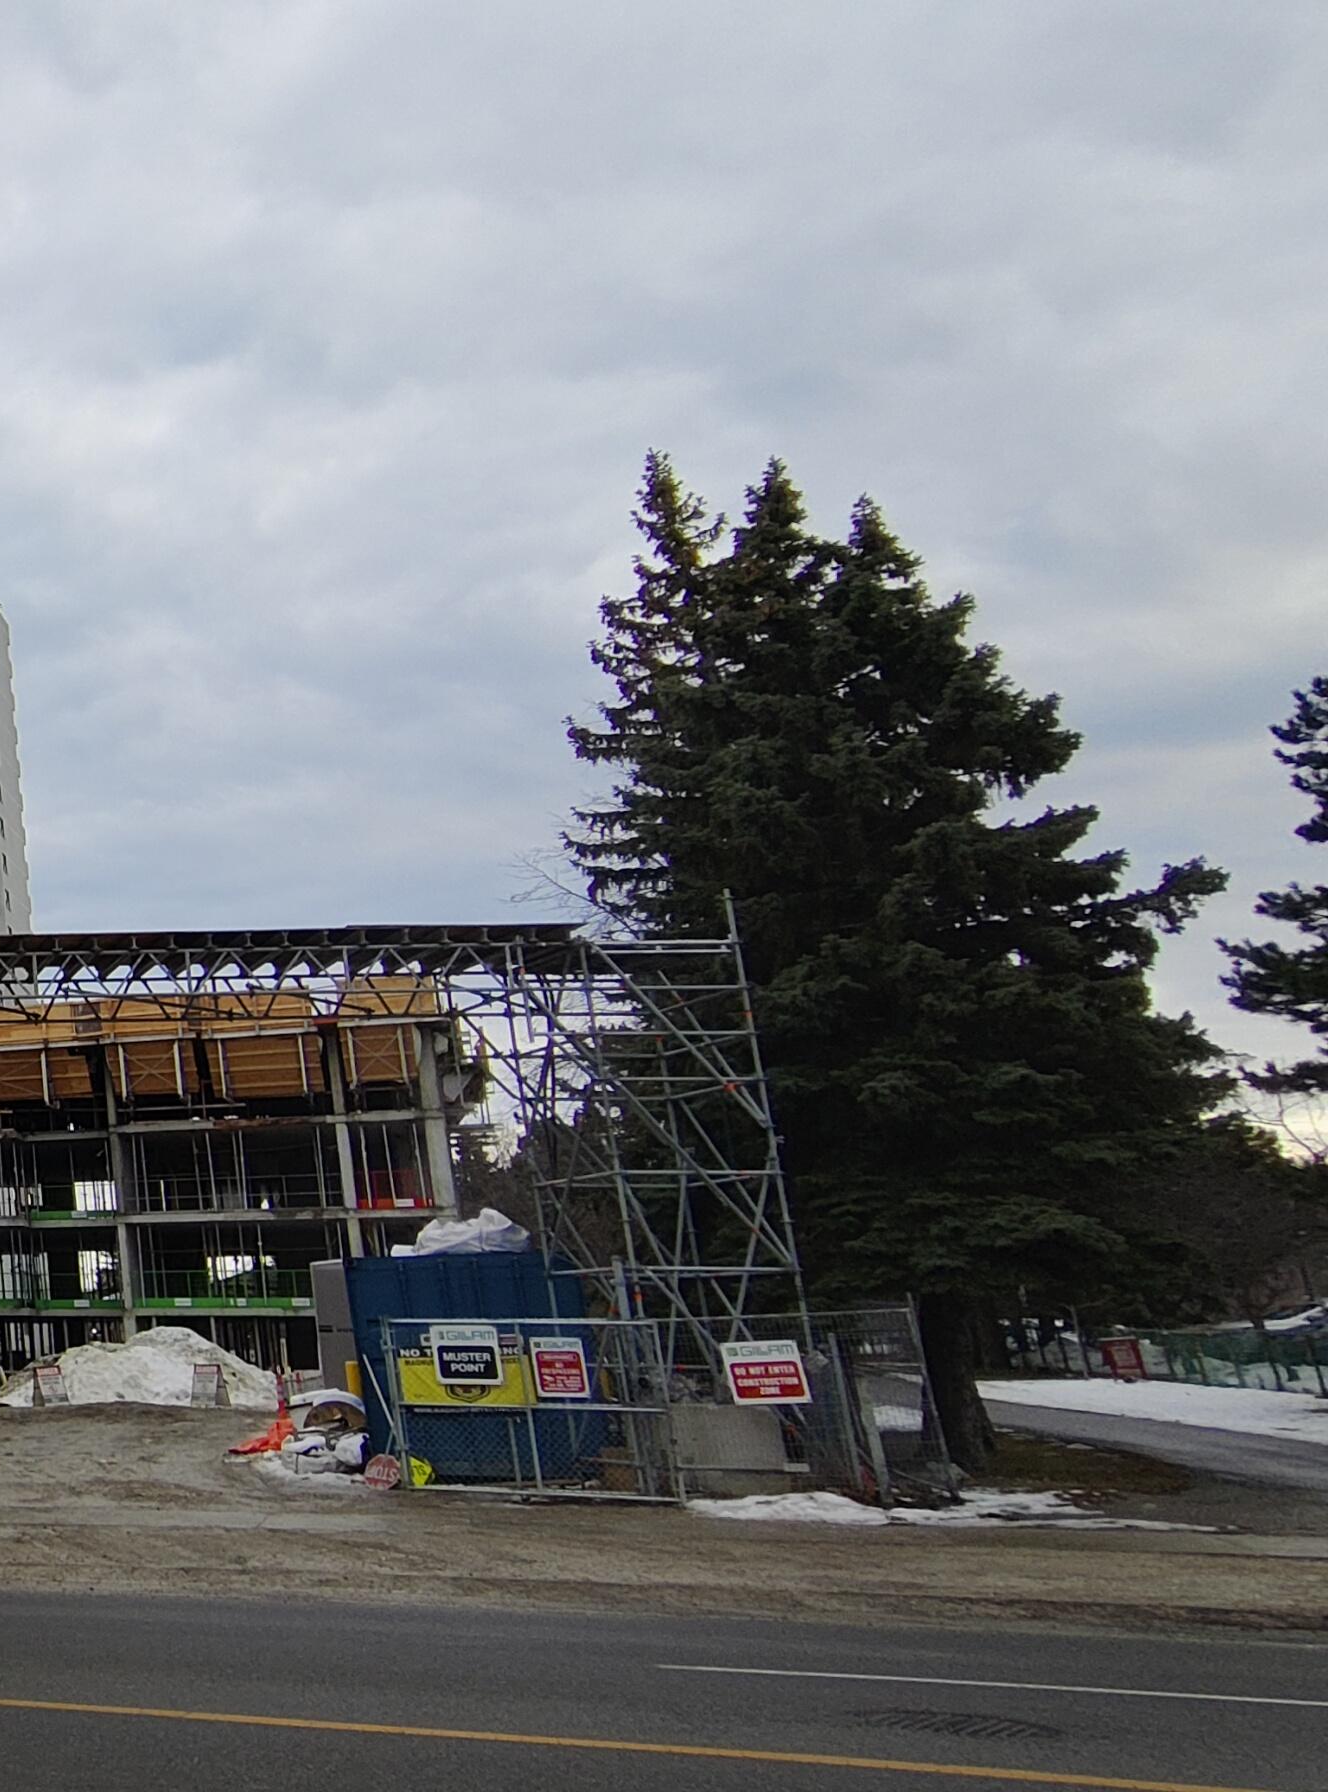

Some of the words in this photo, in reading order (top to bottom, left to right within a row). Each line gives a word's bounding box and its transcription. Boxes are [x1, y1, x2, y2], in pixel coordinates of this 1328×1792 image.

[400, 1348, 420, 1357] NO
[739, 1344, 795, 1357] GILLAM
[442, 1352, 491, 1362] MUSTER
[450, 1363, 485, 1373] POINT
[748, 1366, 766, 1375] NOT
